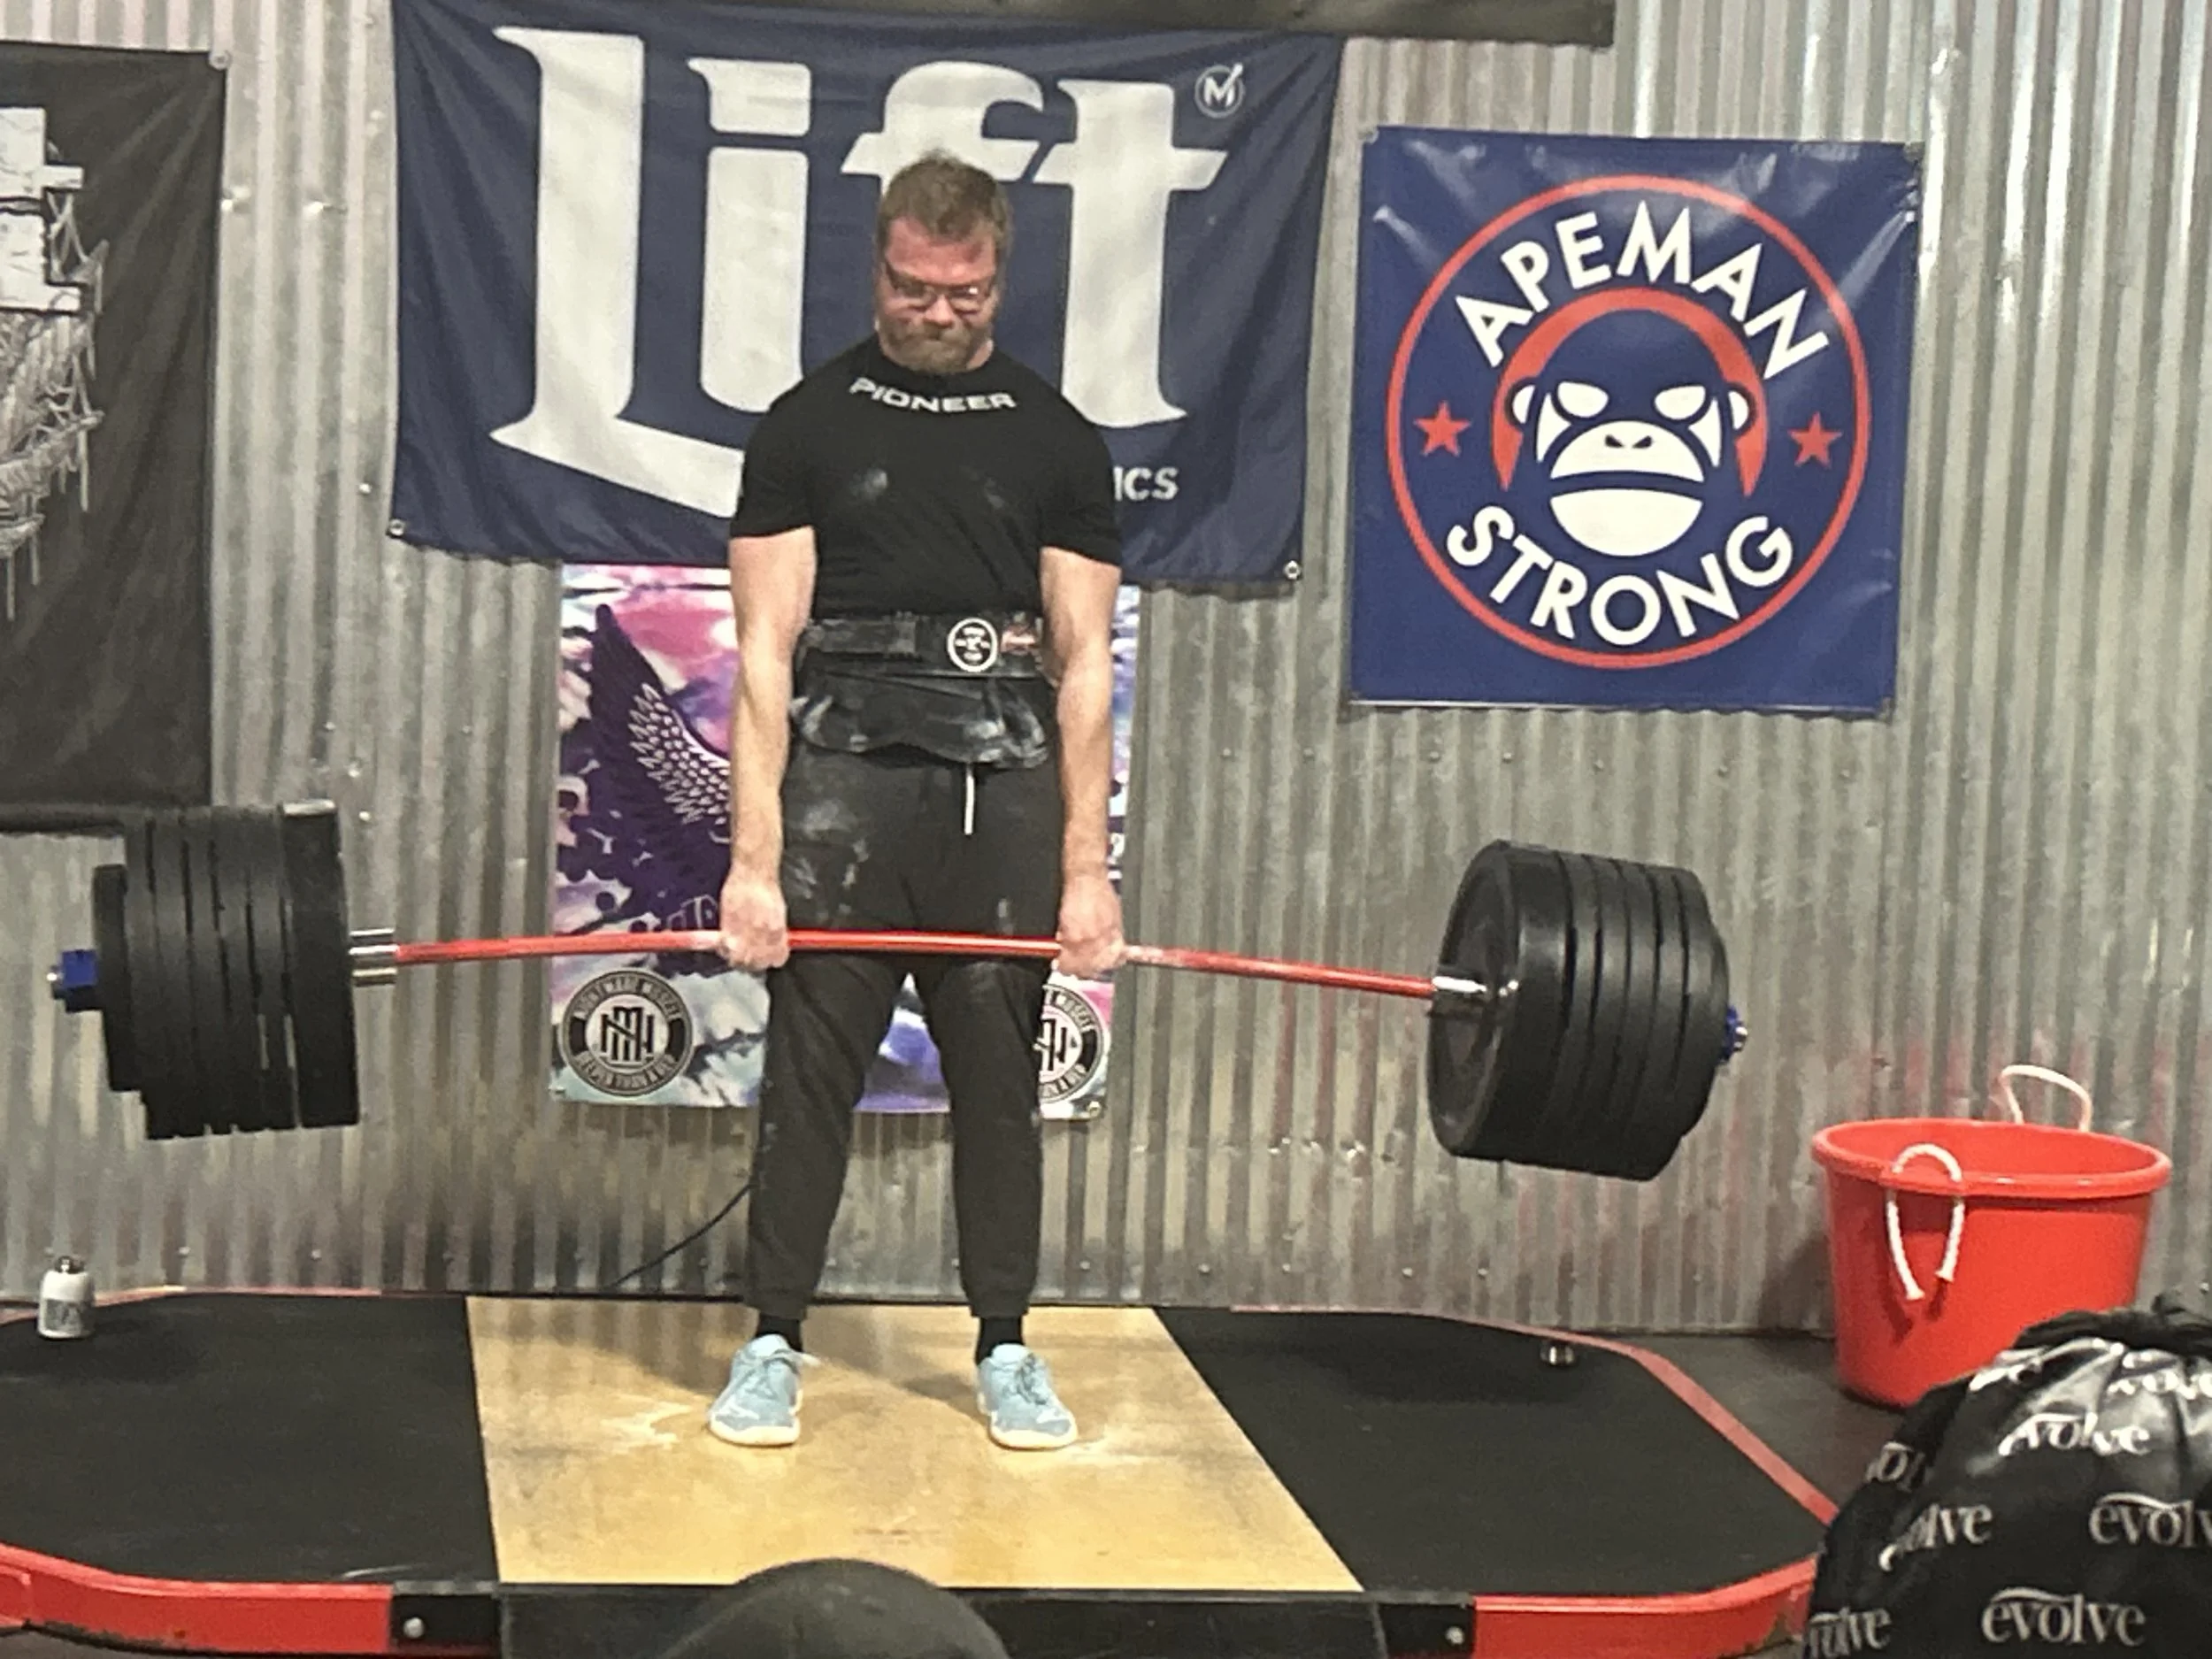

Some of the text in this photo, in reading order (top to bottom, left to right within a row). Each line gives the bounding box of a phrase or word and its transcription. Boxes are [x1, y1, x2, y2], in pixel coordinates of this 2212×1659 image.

[1455, 200, 1830, 380] APEMAN
[849, 377, 1017, 413] PIONEER
[1447, 505, 1793, 646] STRONG
[1982, 1586, 2147, 1647] evolve
